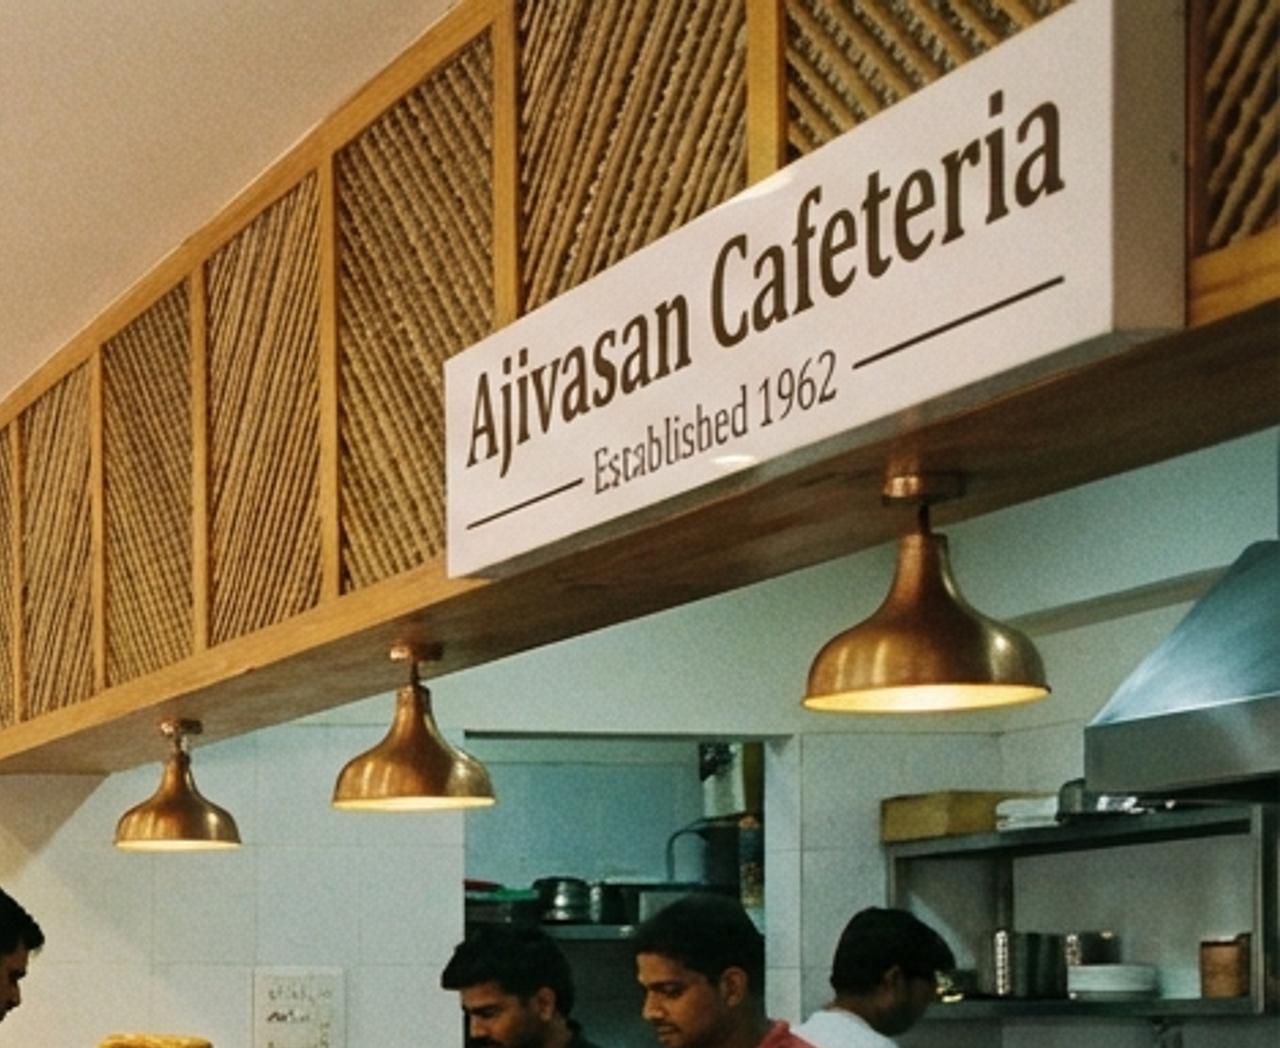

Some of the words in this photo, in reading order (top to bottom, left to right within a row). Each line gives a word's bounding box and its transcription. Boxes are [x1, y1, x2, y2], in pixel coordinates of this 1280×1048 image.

[466, 294, 694, 479] Ajivasan
[710, 89, 1066, 348] Cafeteria
[594, 383, 749, 495] Established
[758, 349, 837, 428] 1962
